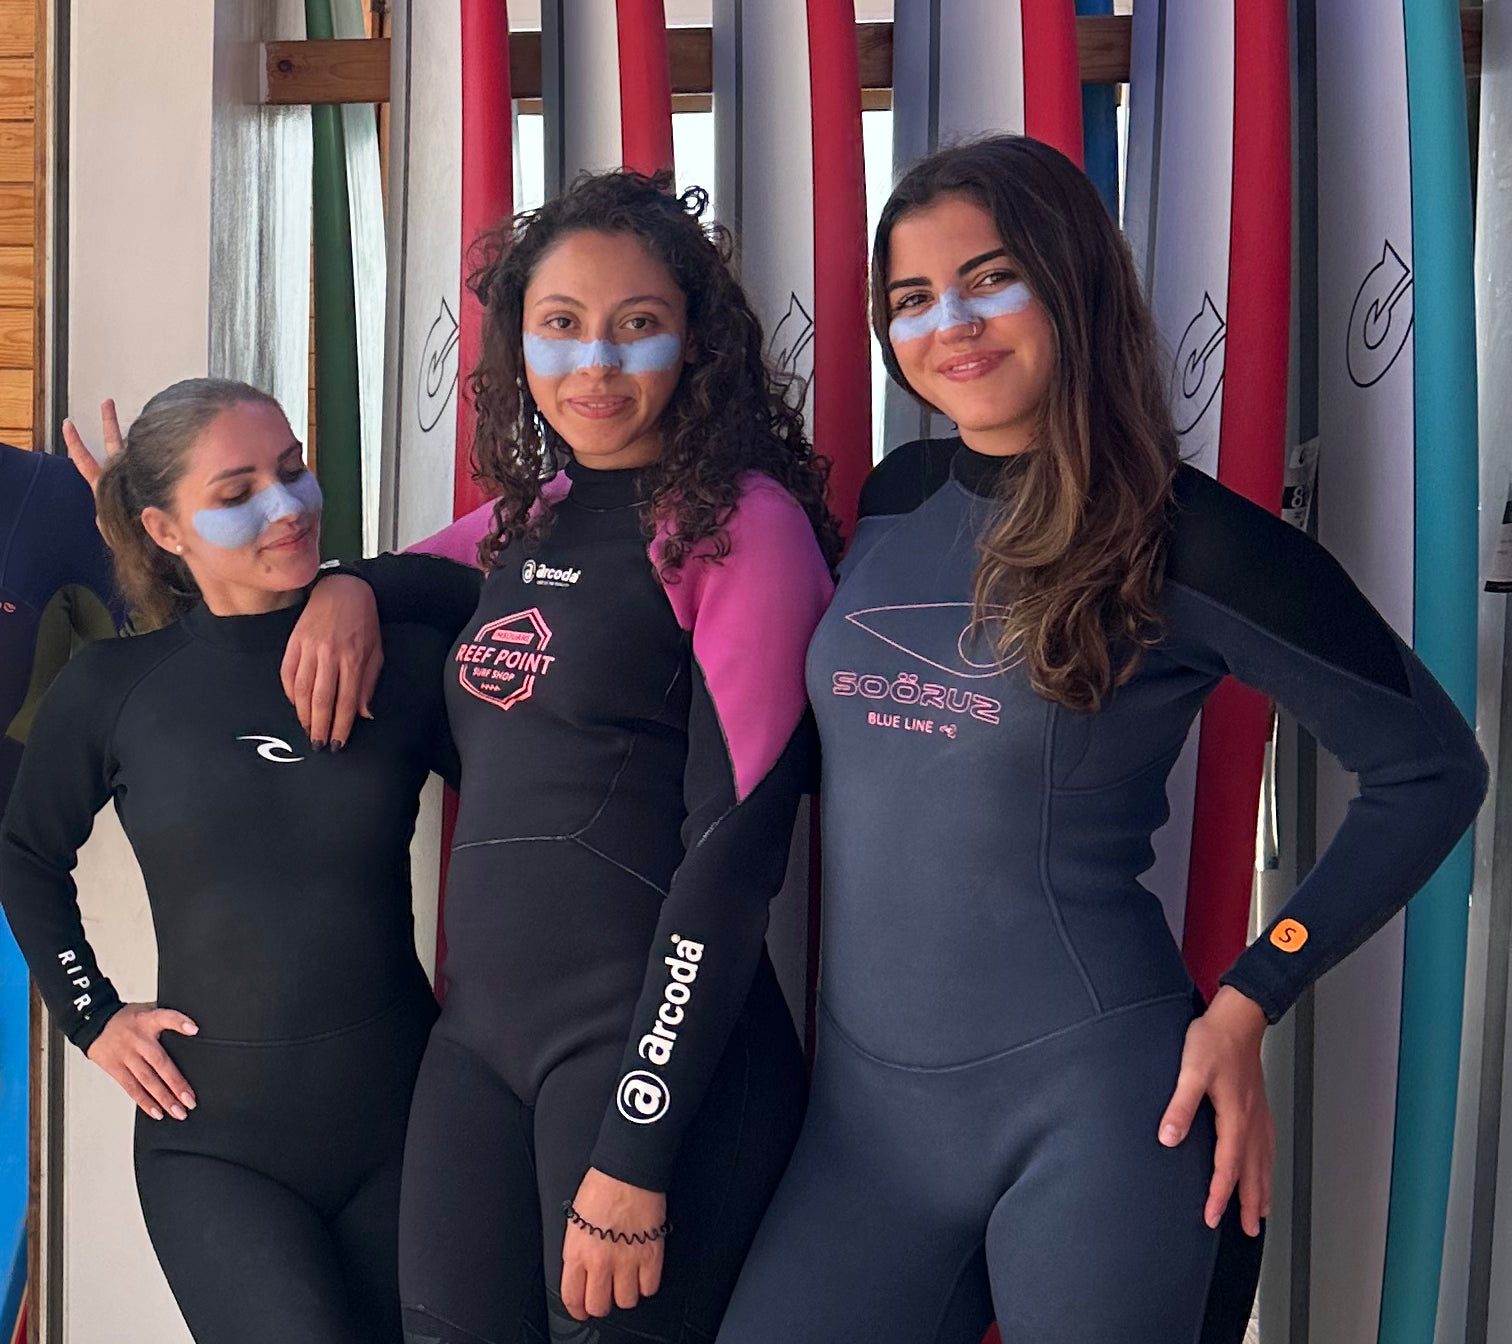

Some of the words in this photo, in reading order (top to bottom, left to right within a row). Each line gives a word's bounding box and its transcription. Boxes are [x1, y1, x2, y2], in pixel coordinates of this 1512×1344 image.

[536, 564, 581, 584] arcoda
[455, 644, 496, 663] REEF
[493, 649, 555, 675] POINT
[472, 667, 491, 680] SURF
[491, 669, 515, 682] SHOP
[832, 671, 1001, 725] SOÖRUZ
[867, 711, 900, 729] BLUE
[904, 716, 934, 734] LINE
[638, 939, 705, 1066] arcoda
